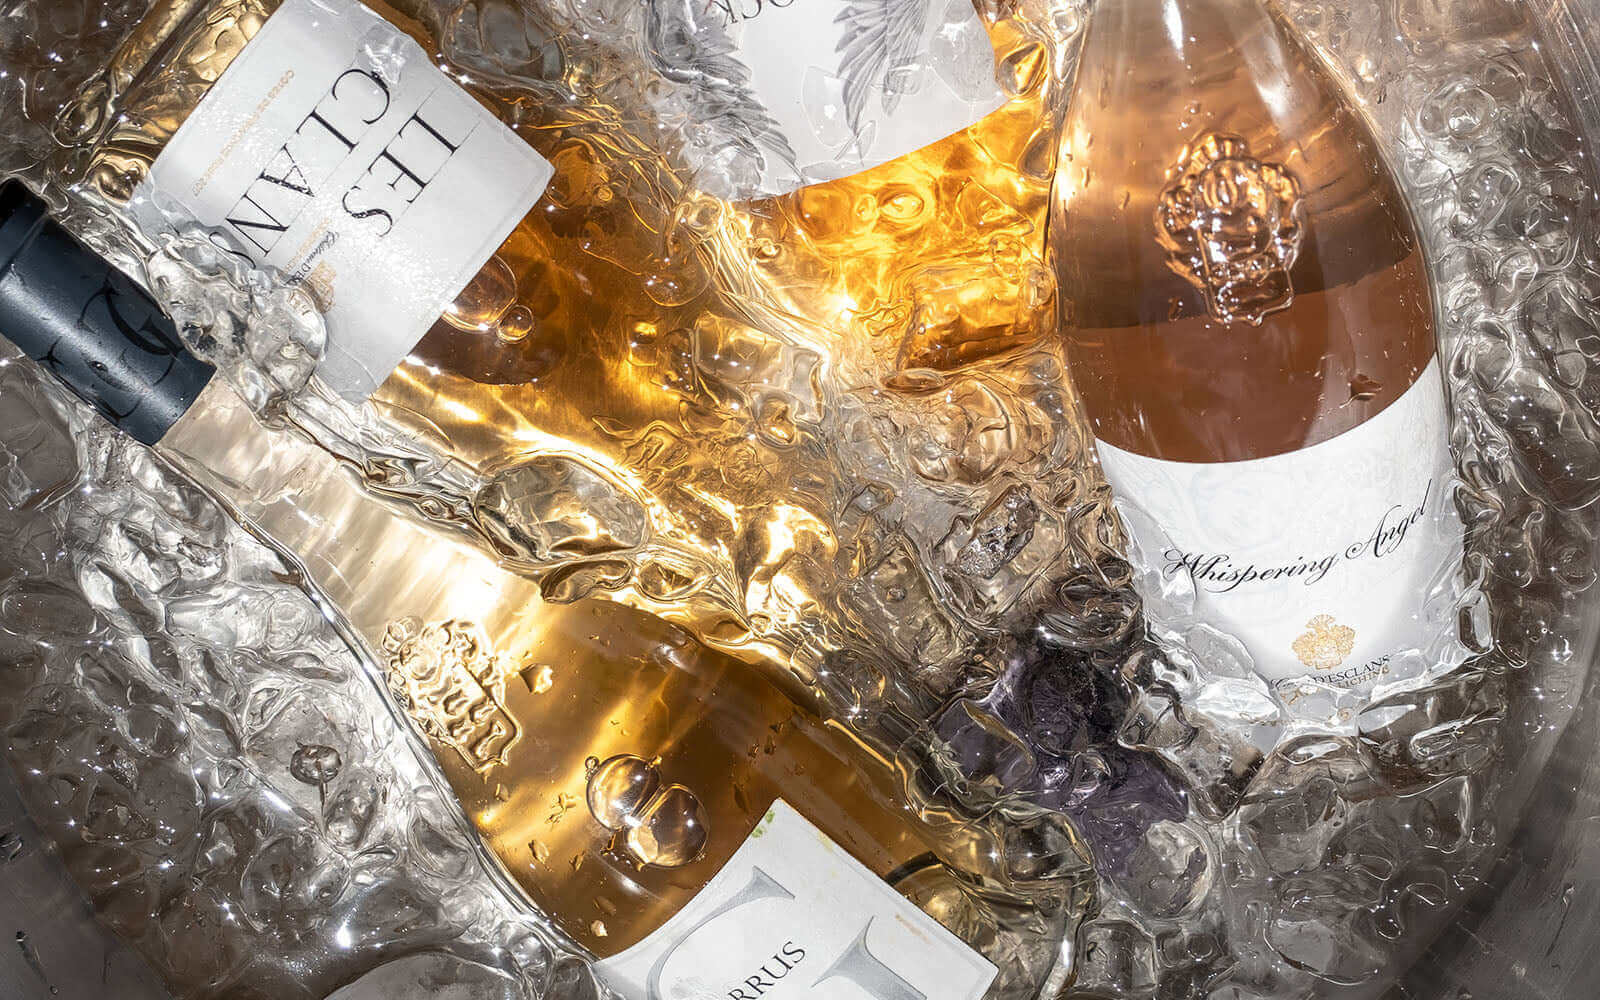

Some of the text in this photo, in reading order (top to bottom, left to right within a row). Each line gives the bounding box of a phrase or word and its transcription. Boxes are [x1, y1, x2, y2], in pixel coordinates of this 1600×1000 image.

[342, 112, 461, 238] LES
[1162, 478, 1433, 593] Whispering Angel
